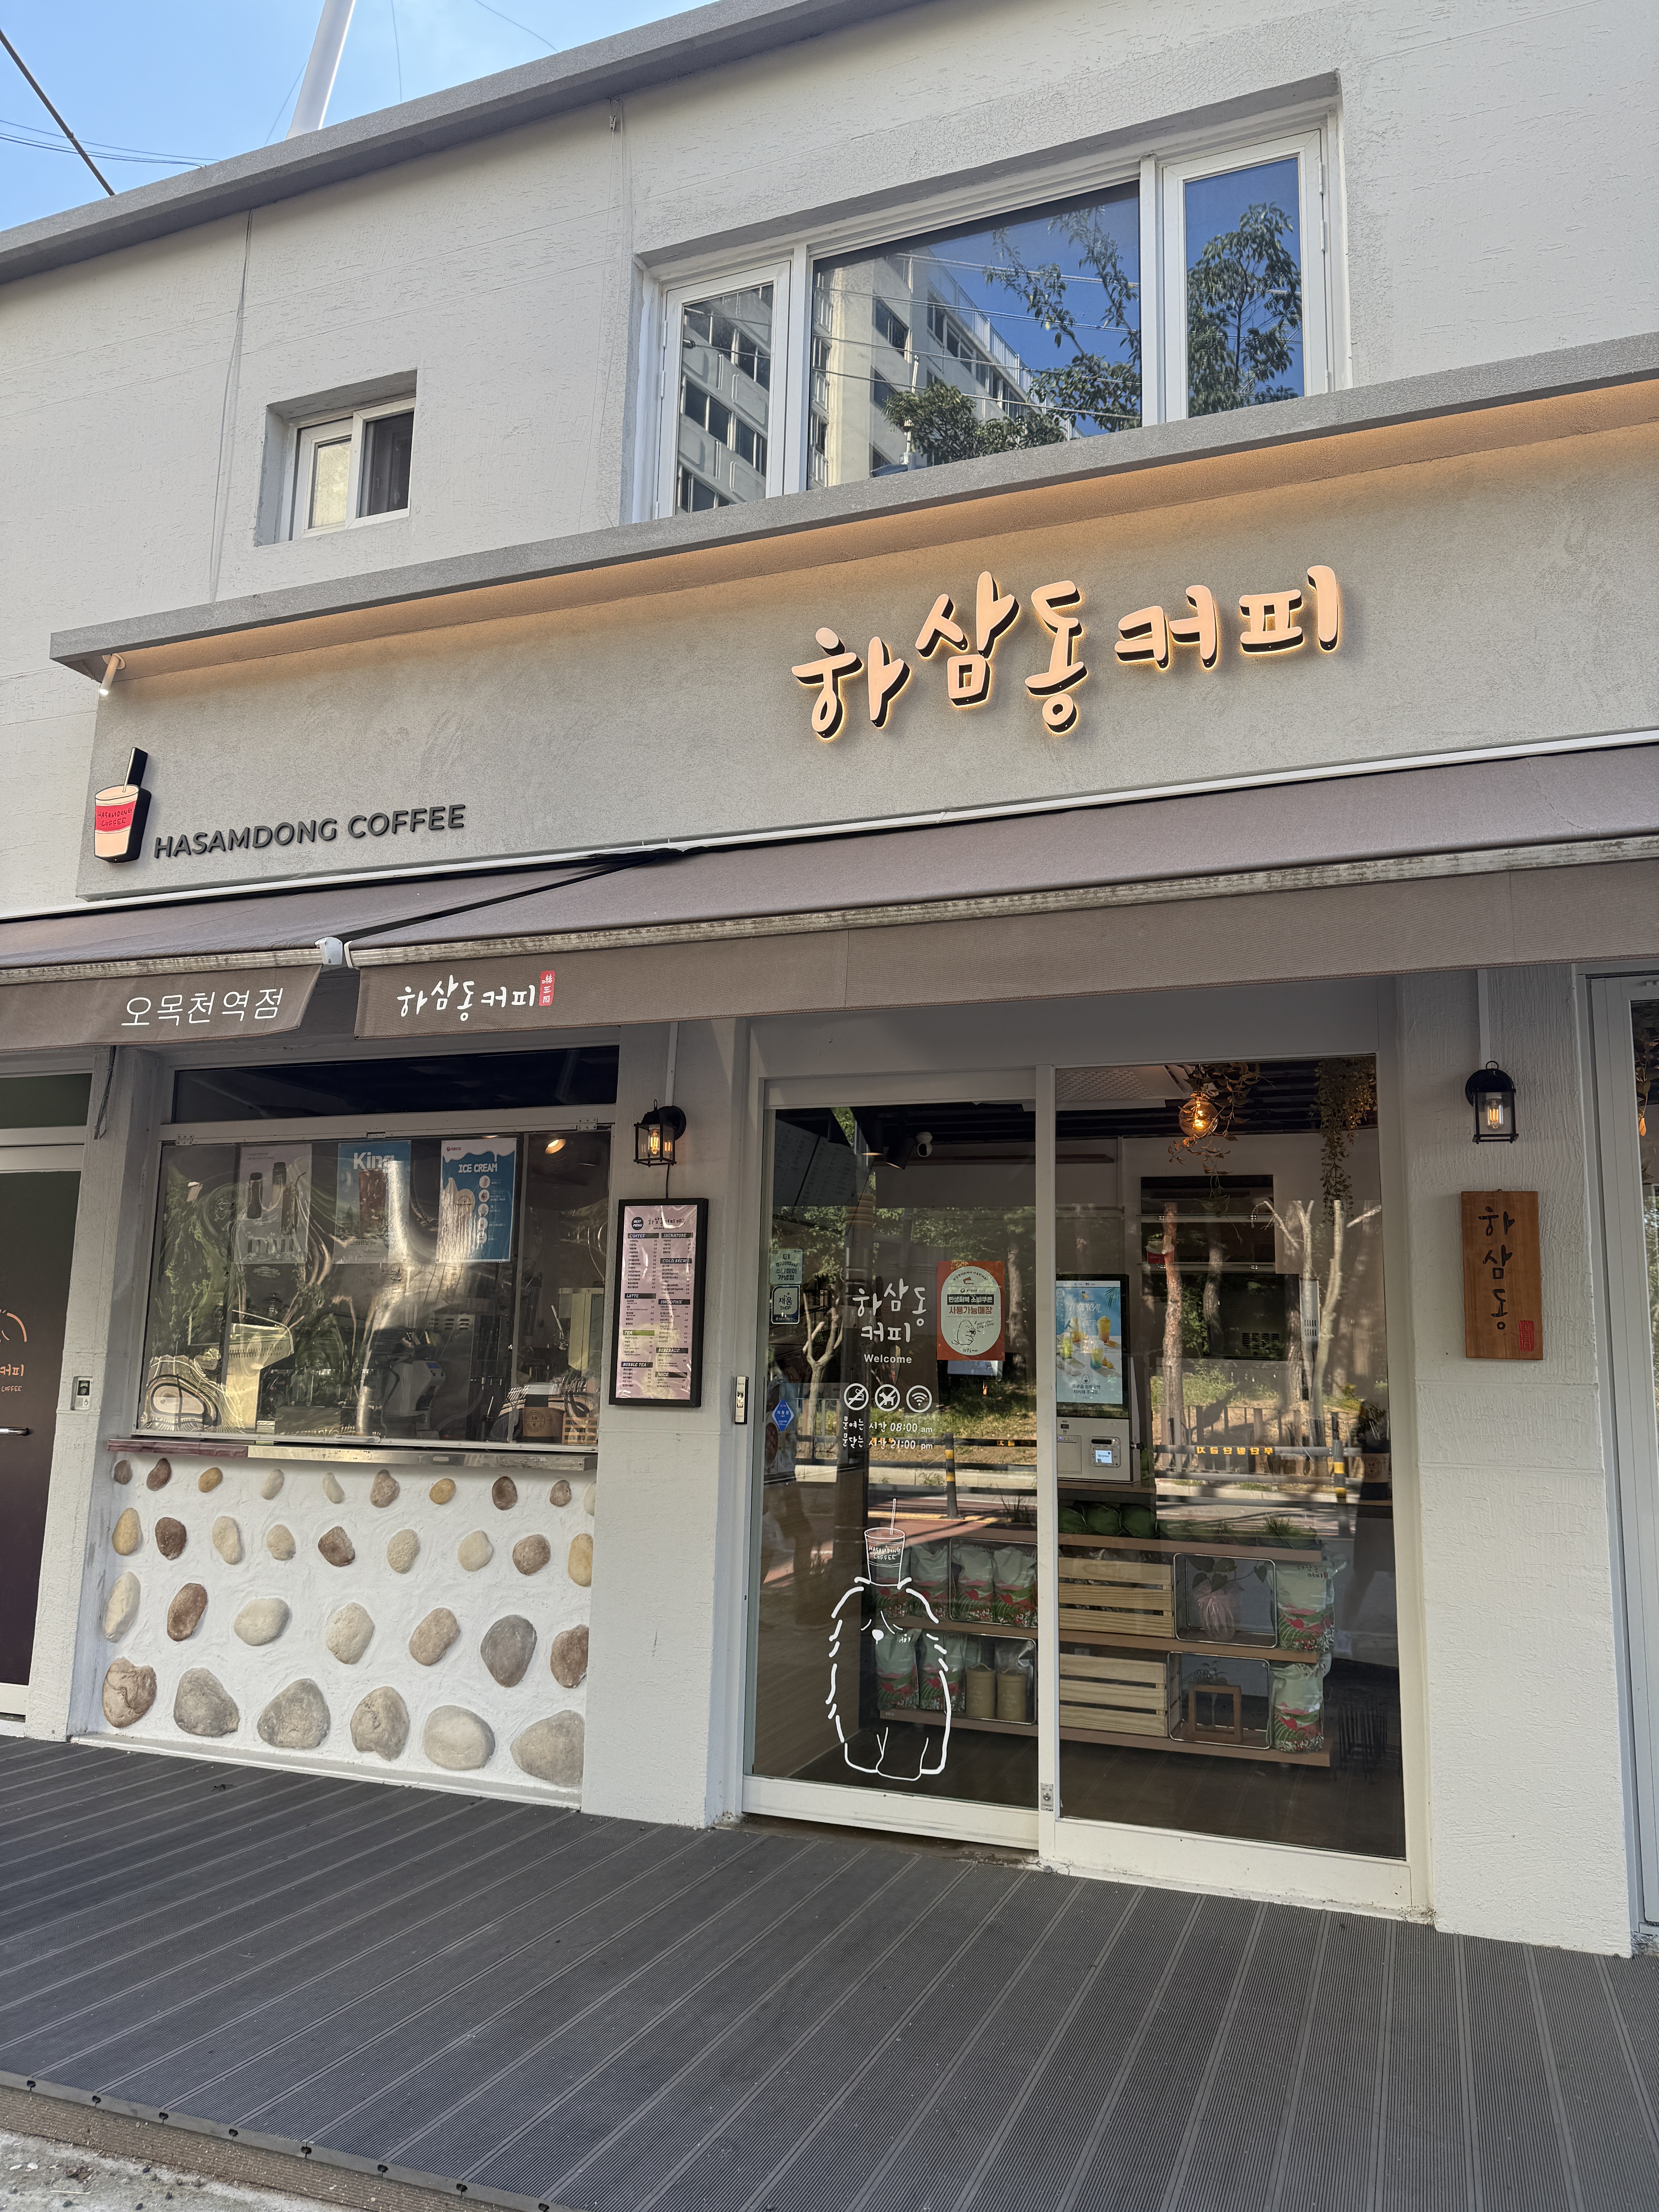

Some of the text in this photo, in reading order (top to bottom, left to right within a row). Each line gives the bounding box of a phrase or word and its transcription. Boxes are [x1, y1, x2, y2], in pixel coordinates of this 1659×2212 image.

[97, 808, 132, 818] HASAMDONG
[101, 817, 126, 826] COFFEE
[155, 804, 465, 859] HASAMDONG COFFEE
[397, 975, 536, 1021] 하삼동커피
[121, 988, 283, 1026] 오목천역점
[459, 1163, 498, 1173] ICE CREAM
[1478, 1206, 1515, 1330] 하삼동
[852, 1278, 927, 1326] 하삼동
[949, 1306, 993, 1314] 사용가능매장
[860, 1322, 910, 1343] 커피
[864, 1354, 912, 1364] Welcome
[0, 1364, 24, 1377] 커피
[843, 1416, 864, 1431] 문여는
[869, 1422, 887, 1432] 시간
[890, 1423, 917, 1432] 08:00
[843, 1433, 864, 1449] 문닫는
[869, 1438, 887, 1449] 시간
[890, 1440, 915, 1449] 21:00
